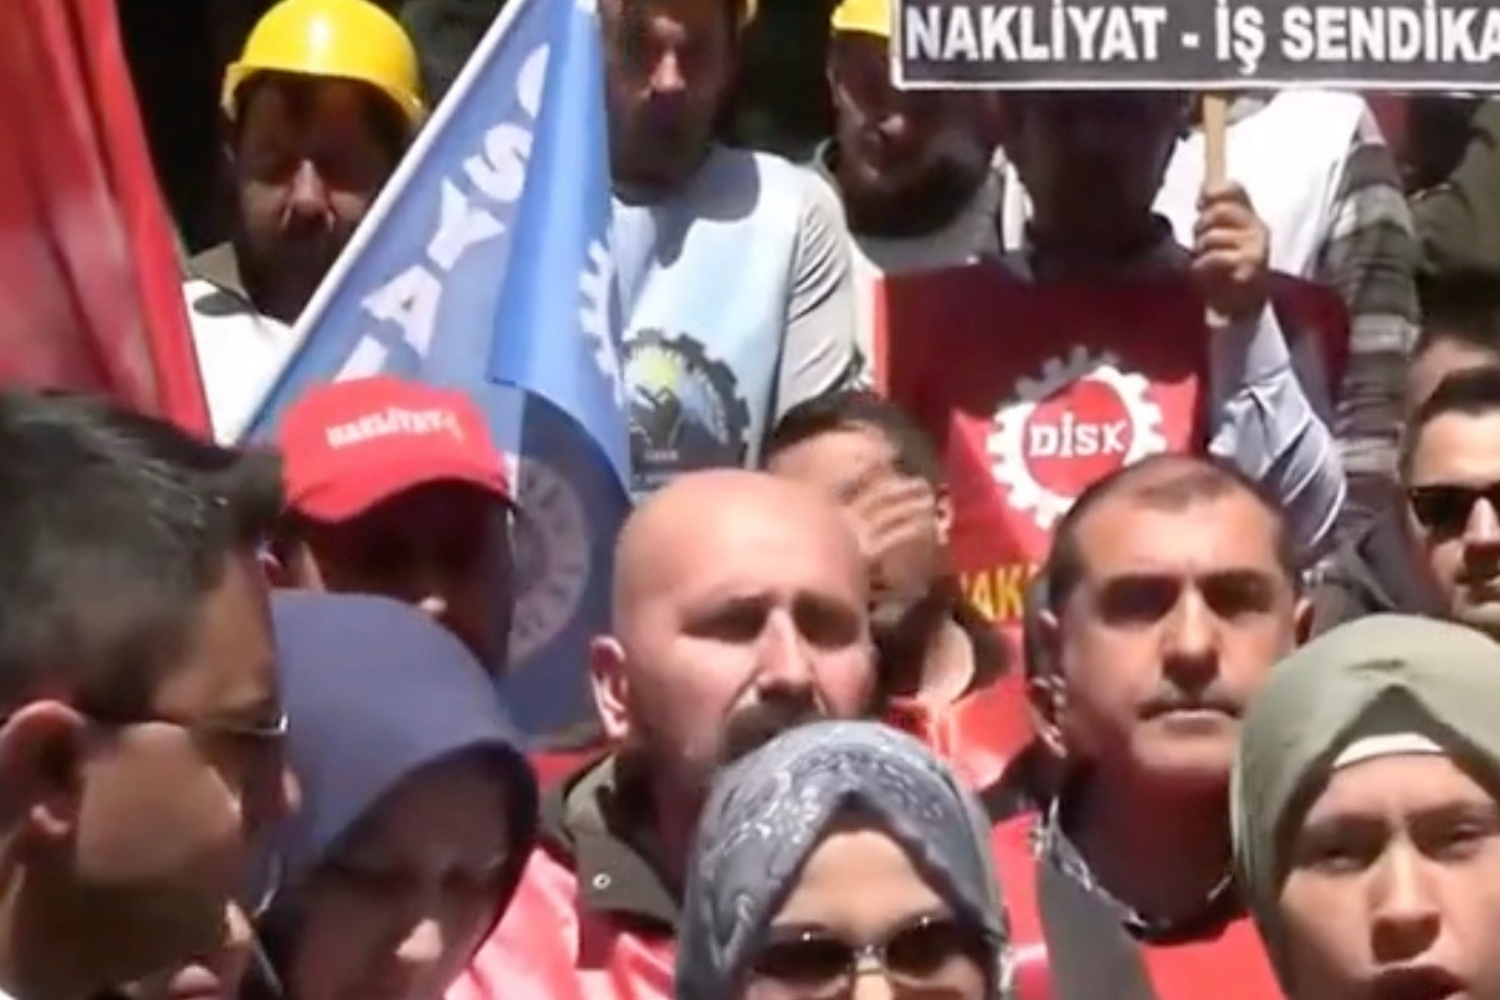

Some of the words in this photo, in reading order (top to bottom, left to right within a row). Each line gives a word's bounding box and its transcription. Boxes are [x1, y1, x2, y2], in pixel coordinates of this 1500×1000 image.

[906, 0, 1167, 61] NAKLİYAT
[1215, 0, 1265, 74] İŞ
[1029, 411, 1127, 457] DİSK
